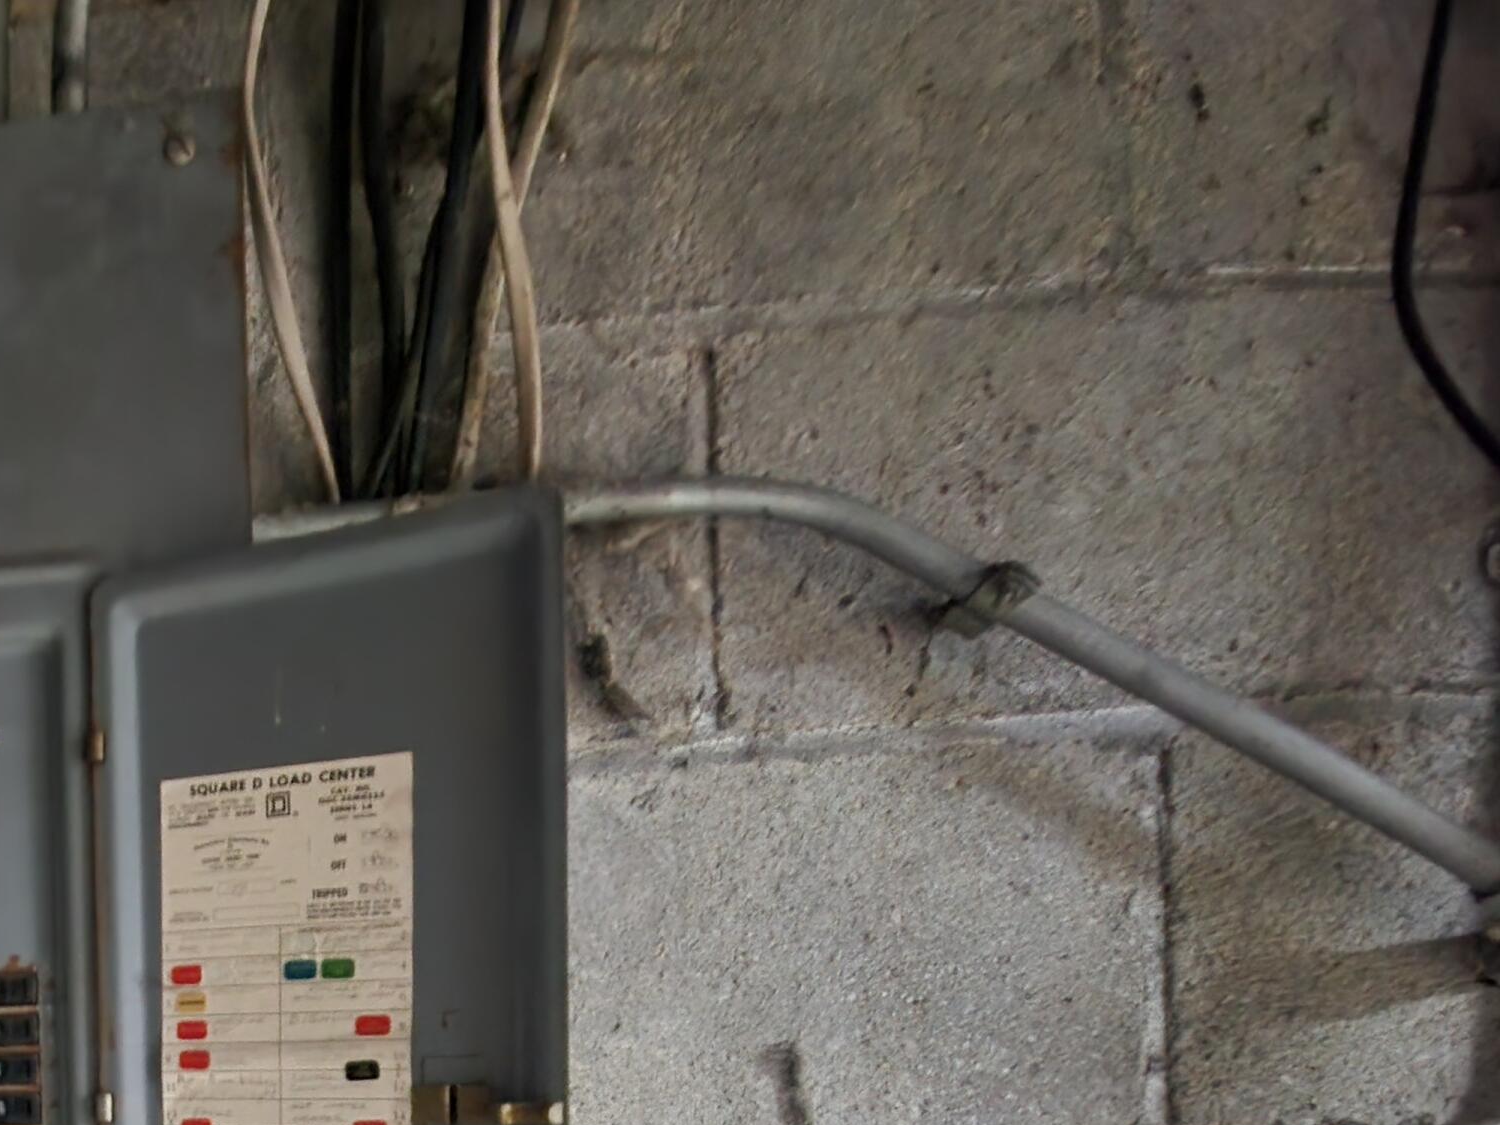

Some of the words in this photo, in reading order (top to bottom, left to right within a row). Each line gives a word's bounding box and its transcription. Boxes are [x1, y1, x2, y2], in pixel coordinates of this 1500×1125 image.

[190, 779, 245, 797] SQUARE
[252, 777, 263, 789] D
[269, 772, 312, 788] LOAD
[318, 765, 376, 783] CENTER
[333, 832, 348, 844] ON
[330, 858, 347, 871] OFF
[312, 886, 349, 899] TRIPPED
